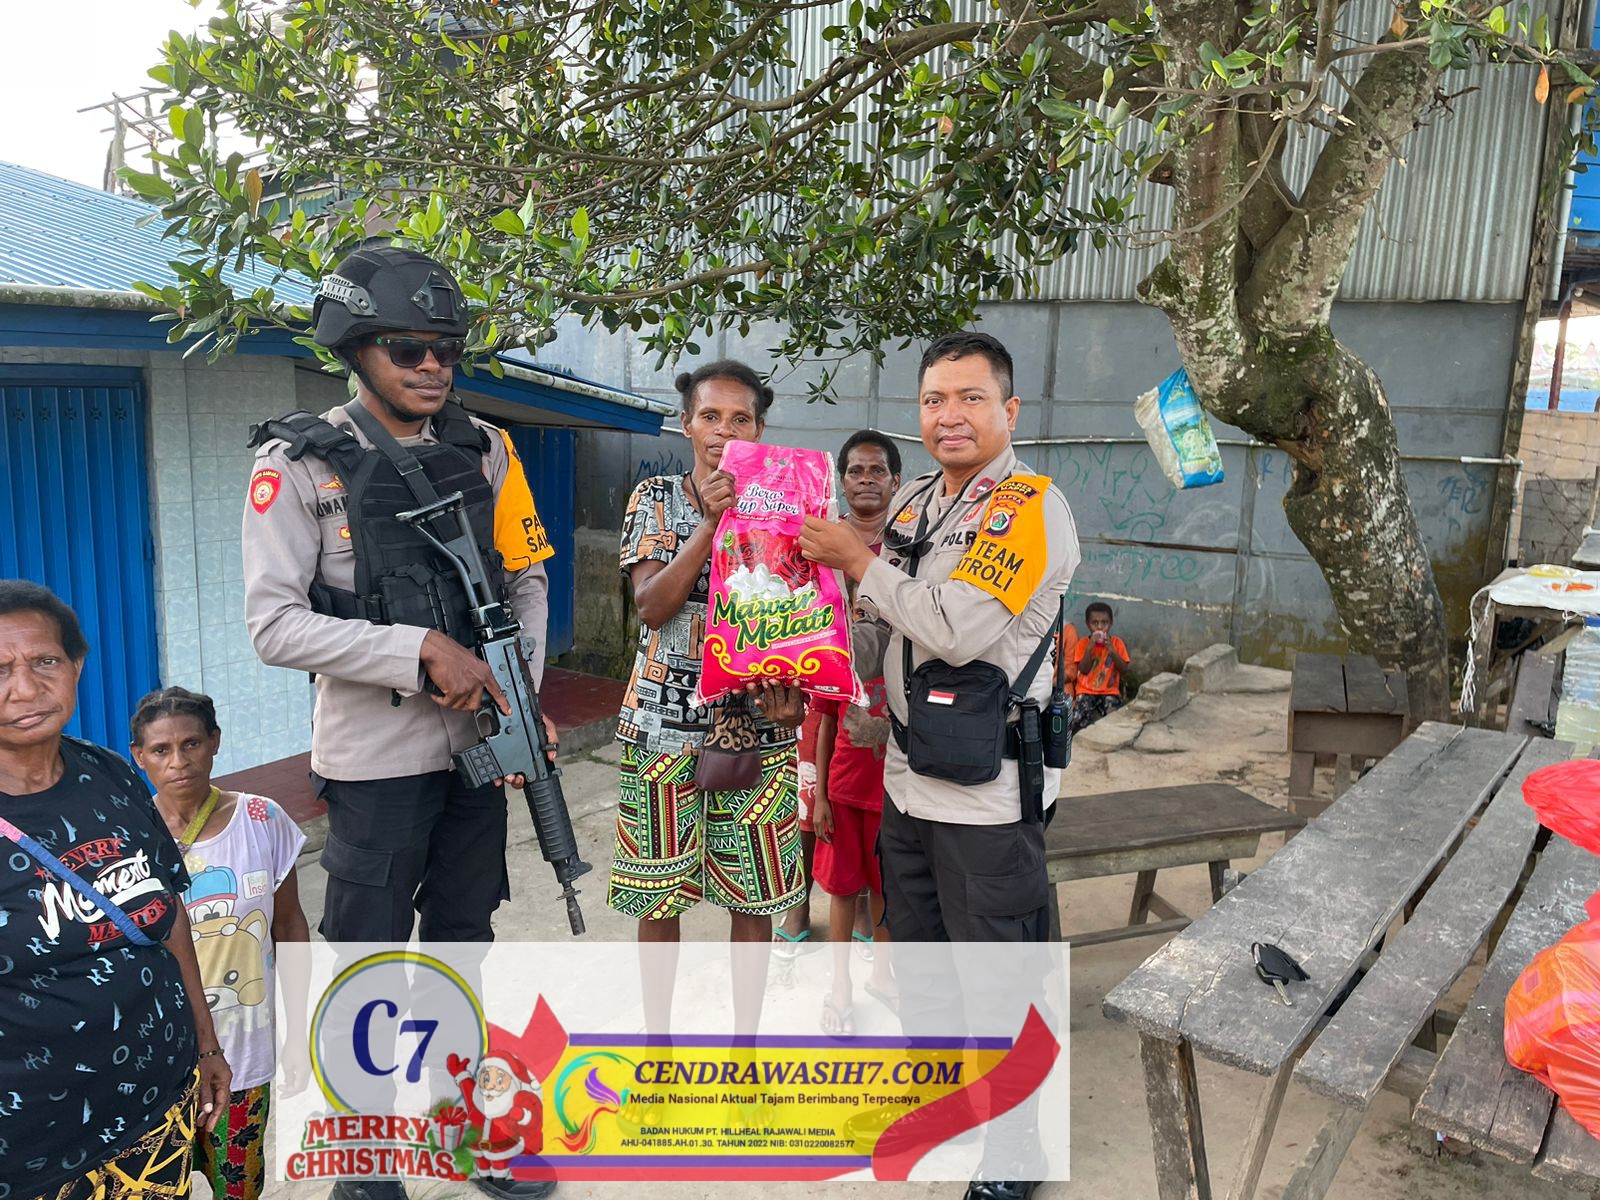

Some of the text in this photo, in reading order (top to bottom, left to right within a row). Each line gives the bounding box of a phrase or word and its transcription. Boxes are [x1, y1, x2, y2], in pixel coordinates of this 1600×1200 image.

[745, 484, 784, 500] Beras
[762, 498, 799, 515] Super
[998, 495, 1021, 505] PAPUA
[975, 540, 1025, 575] TEAM
[712, 588, 817, 628] Mawar
[735, 603, 835, 653] Melati
[88, 899, 167, 942] MATER
